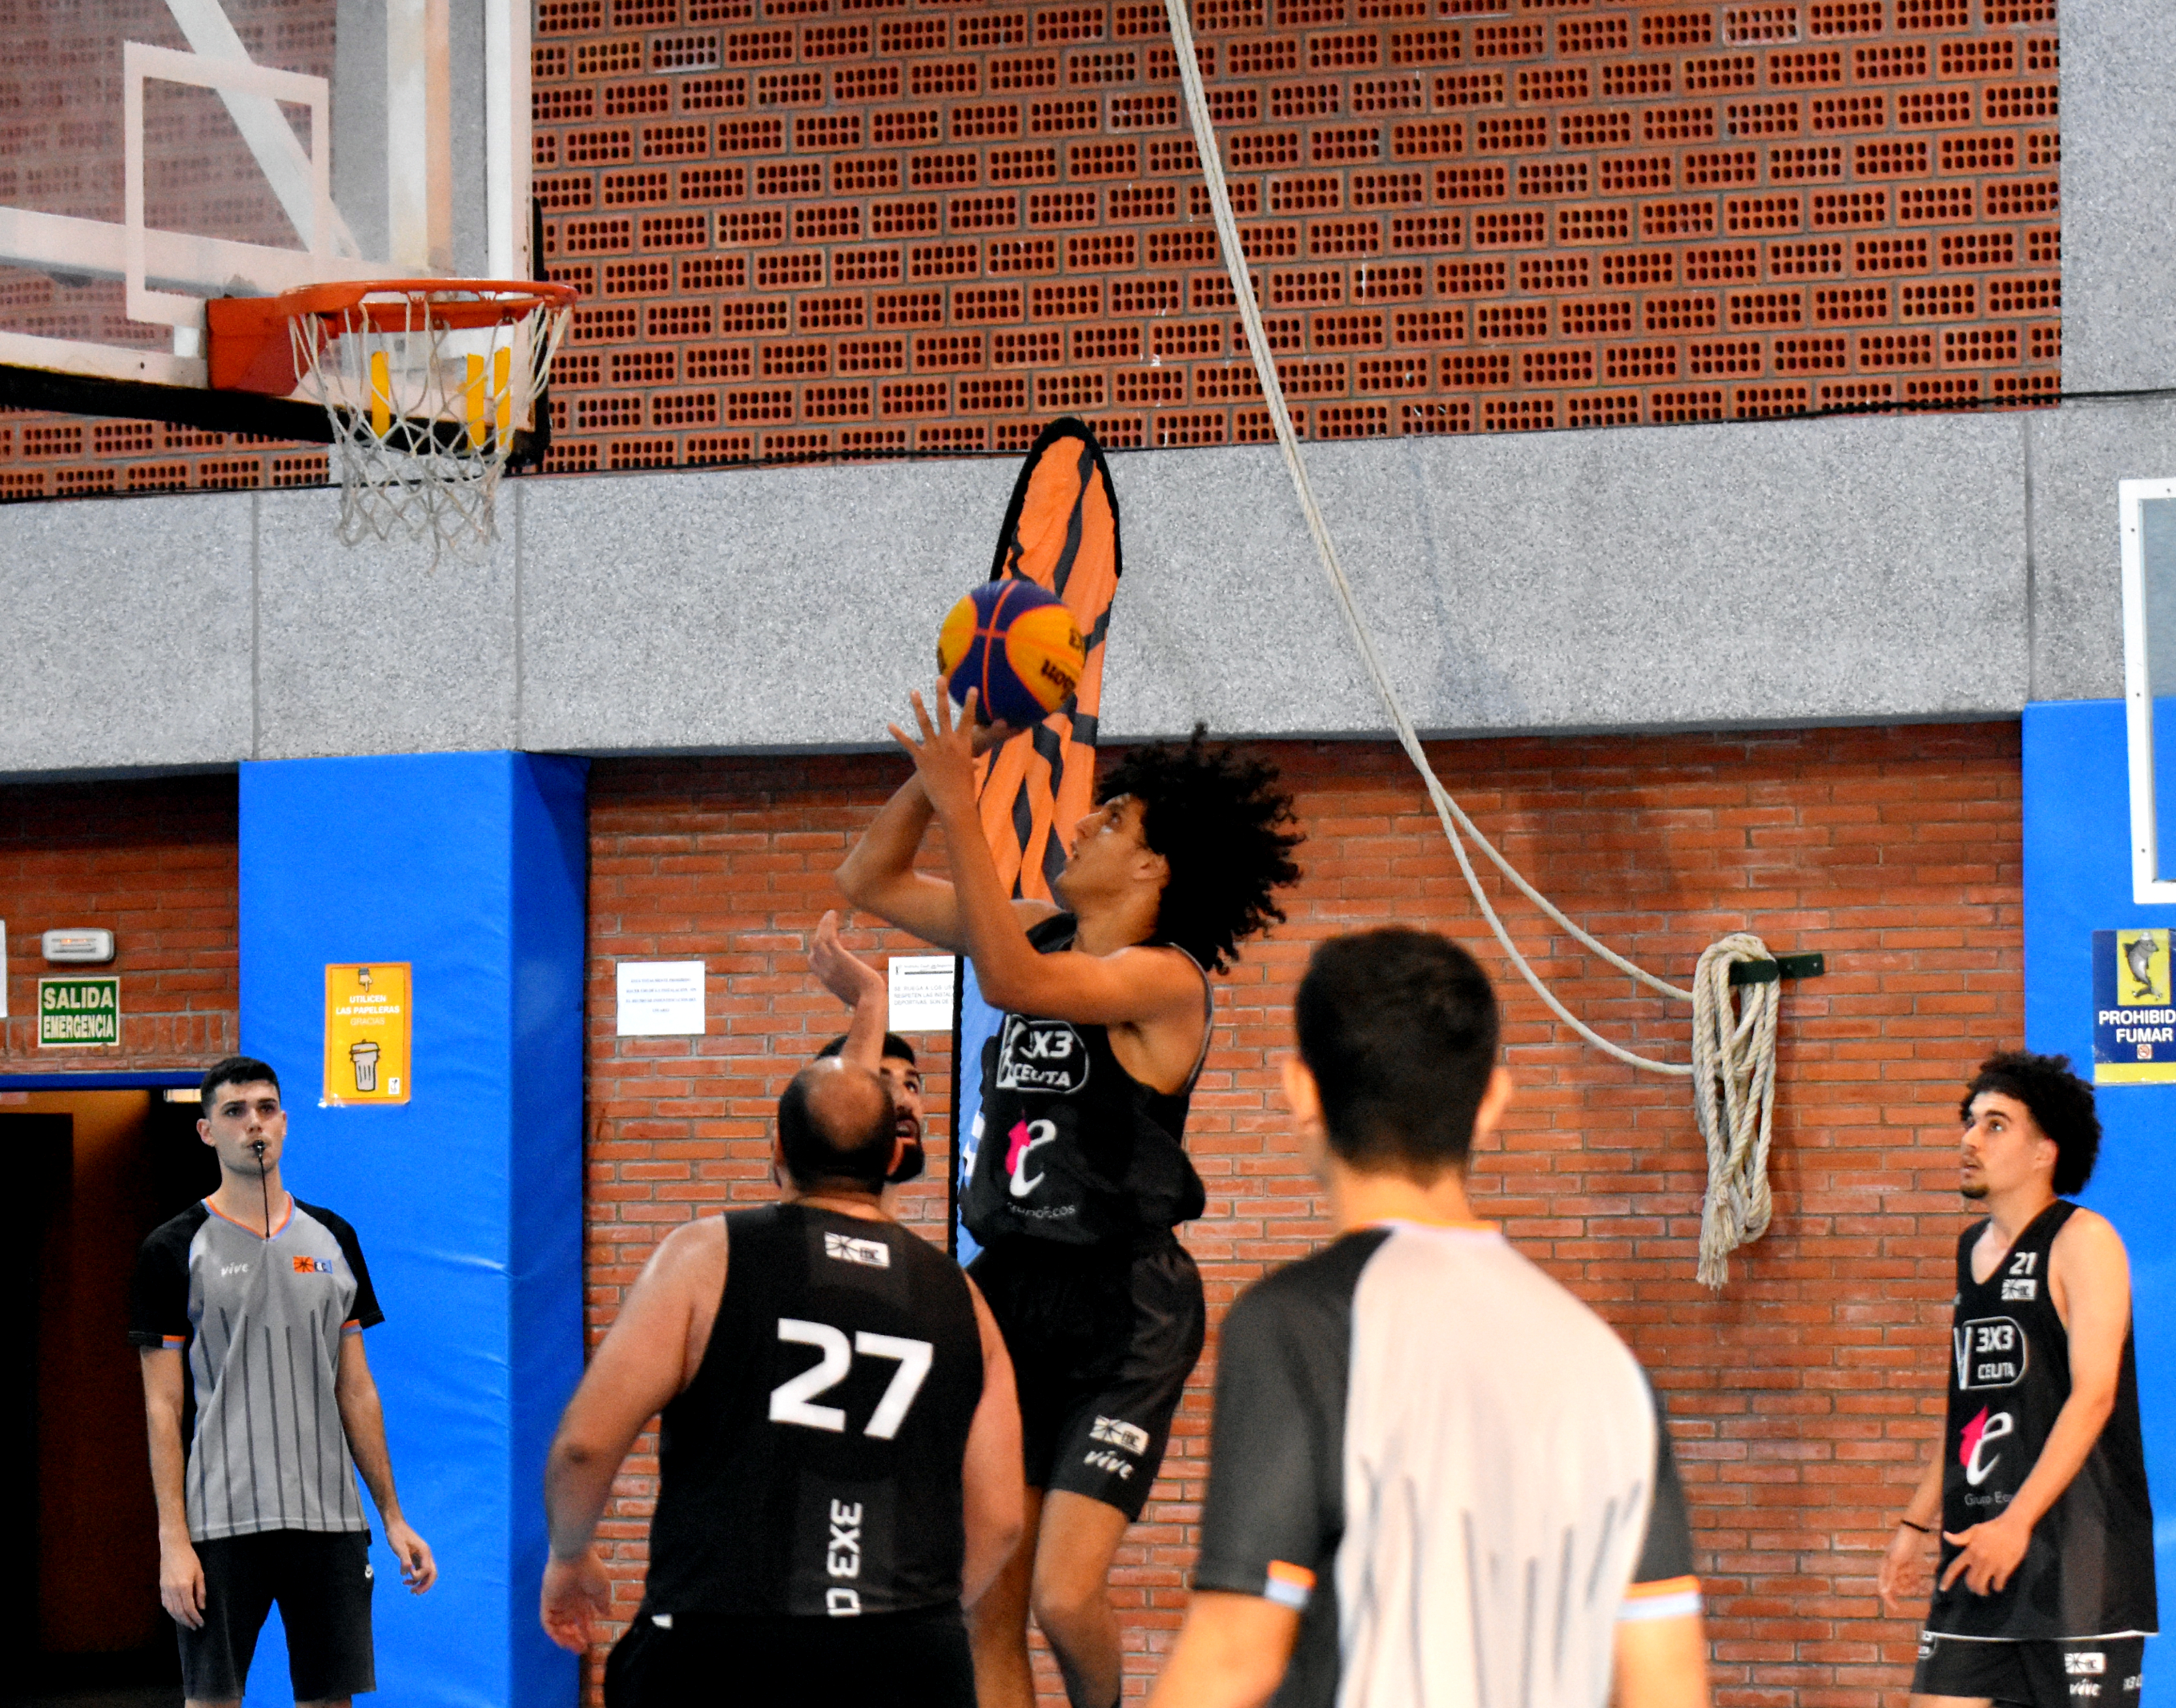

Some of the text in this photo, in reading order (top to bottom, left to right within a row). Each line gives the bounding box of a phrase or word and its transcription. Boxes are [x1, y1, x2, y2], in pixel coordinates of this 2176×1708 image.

[43, 986, 114, 1010] SALIDA
[349, 995, 387, 1003] UTILICEN
[336, 1005, 400, 1015] LAS PAPELERAS
[43, 1014, 114, 1039] EMERGENCIA
[350, 1017, 386, 1026] GRACIAS
[2116, 1027, 2174, 1043] FUMAR
[220, 1261, 249, 1277] vive
[2009, 1252, 2038, 1275] 21
[1975, 1325, 2014, 1352] 3X3
[768, 1317, 934, 1441] 27
[1977, 1362, 2016, 1380] CEUTA
